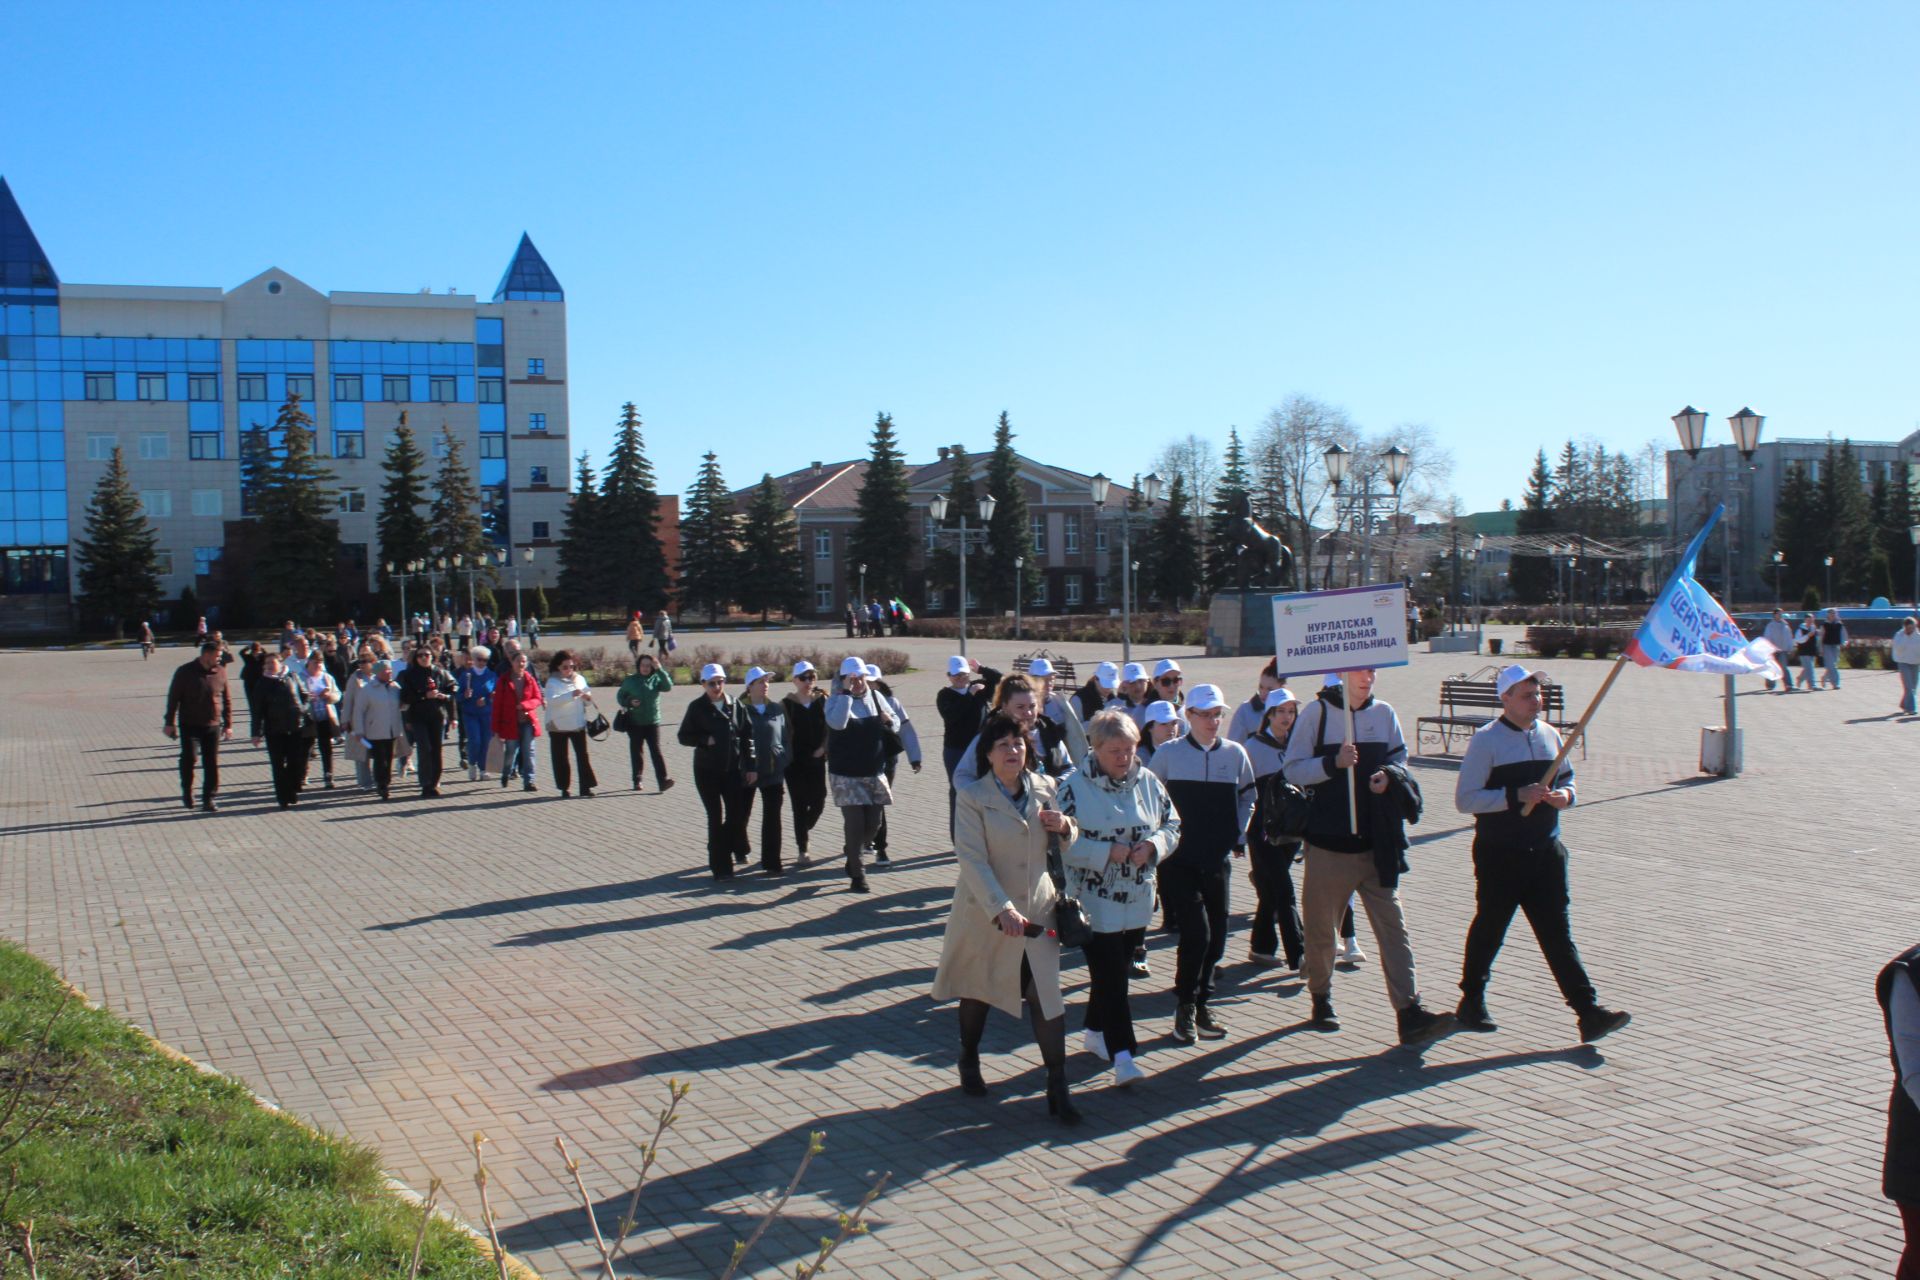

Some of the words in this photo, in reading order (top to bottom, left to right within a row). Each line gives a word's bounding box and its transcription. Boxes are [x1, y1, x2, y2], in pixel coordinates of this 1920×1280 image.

[1307, 617, 1373, 632] НУРЛАТСКАЯ
[1305, 628, 1377, 645] ЦЕНТРАЛЬНАЯ
[1287, 643, 1340, 657] РАЙОННАЯ
[1343, 637, 1397, 652] БОЛЬНИЦА
